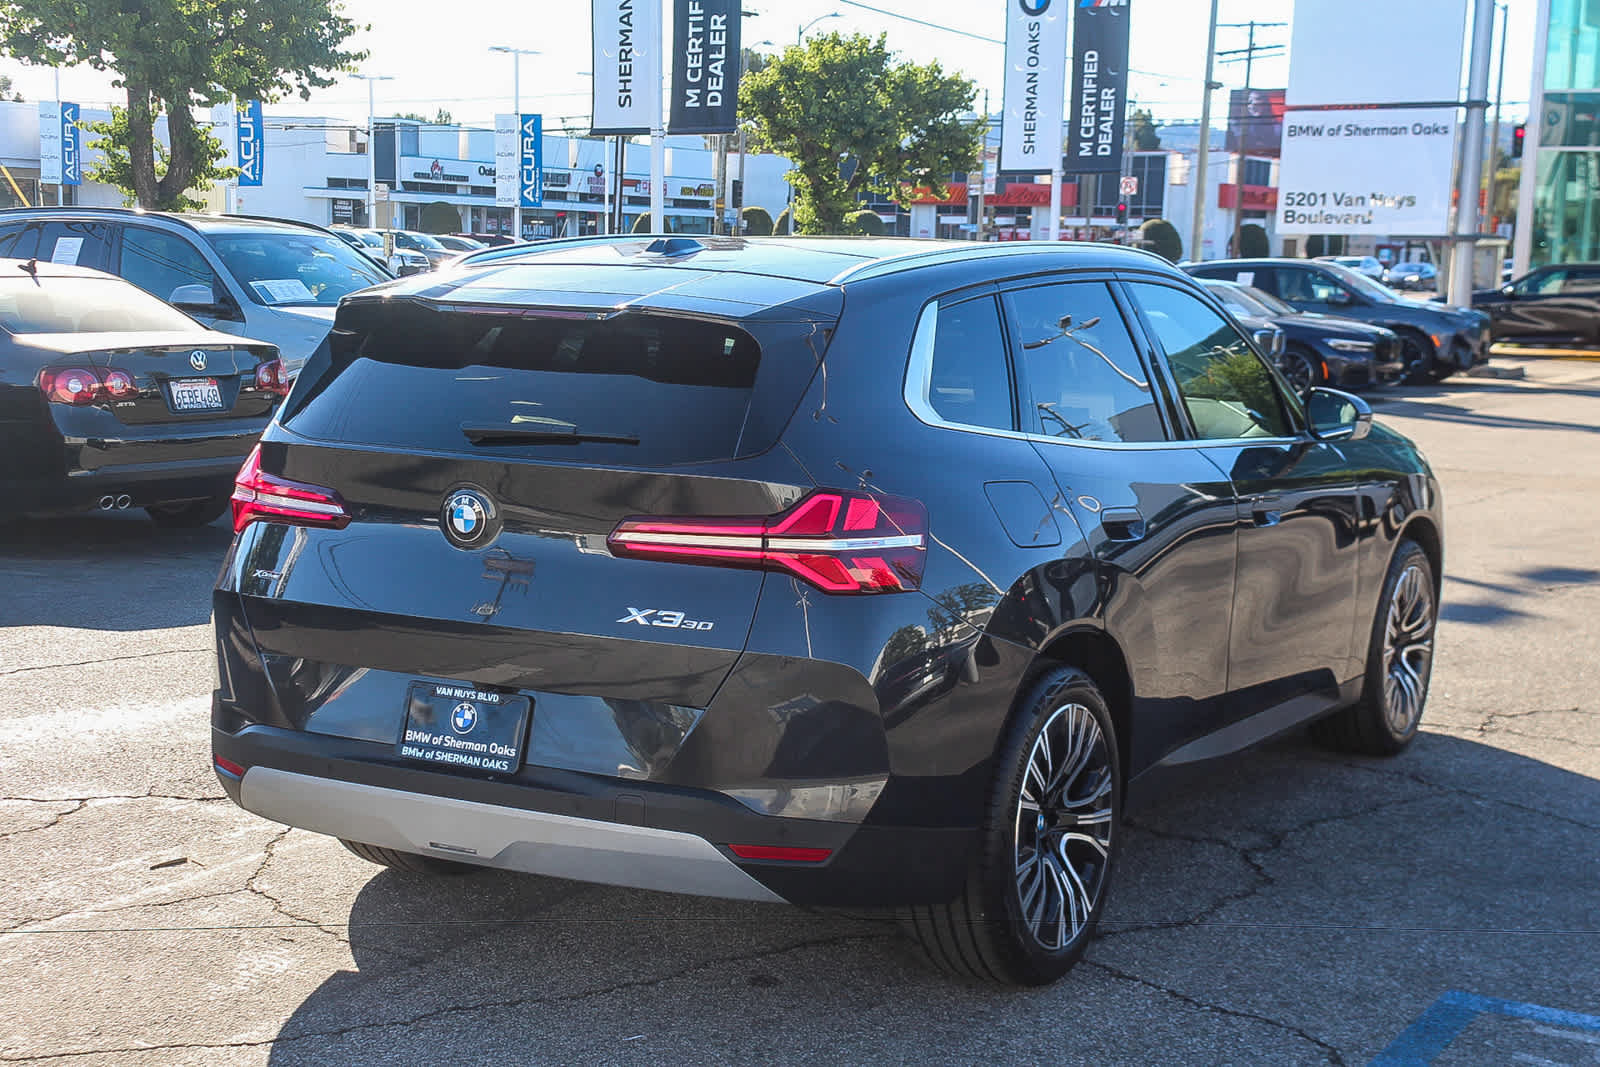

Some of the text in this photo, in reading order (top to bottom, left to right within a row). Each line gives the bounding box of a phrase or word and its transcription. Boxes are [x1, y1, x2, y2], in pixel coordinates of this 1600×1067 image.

[617, 0, 633, 108] SHERMAN
[706, 14, 727, 107] DEALER
[685, 88, 701, 108] M
[1023, 21, 1040, 155] SHERMAN OAKS
[1079, 50, 1099, 157] M CERTIFIED
[1097, 87, 1116, 156] DEALER
[1287, 122, 1449, 137] BMW of Sherman Oaks
[64, 107, 75, 180] ACURA
[523, 118, 535, 202] ACURA
[1284, 192, 1327, 206] 5201
[1332, 192, 1365, 206] Van
[1284, 209, 1373, 224] Boulevard
[615, 607, 685, 628] X3
[435, 686, 500, 702] VAN NUYS BLVD
[405, 730, 516, 757] BMW of Sherman Oaks
[401, 746, 509, 771] BMW of SHERMAN OAKS
